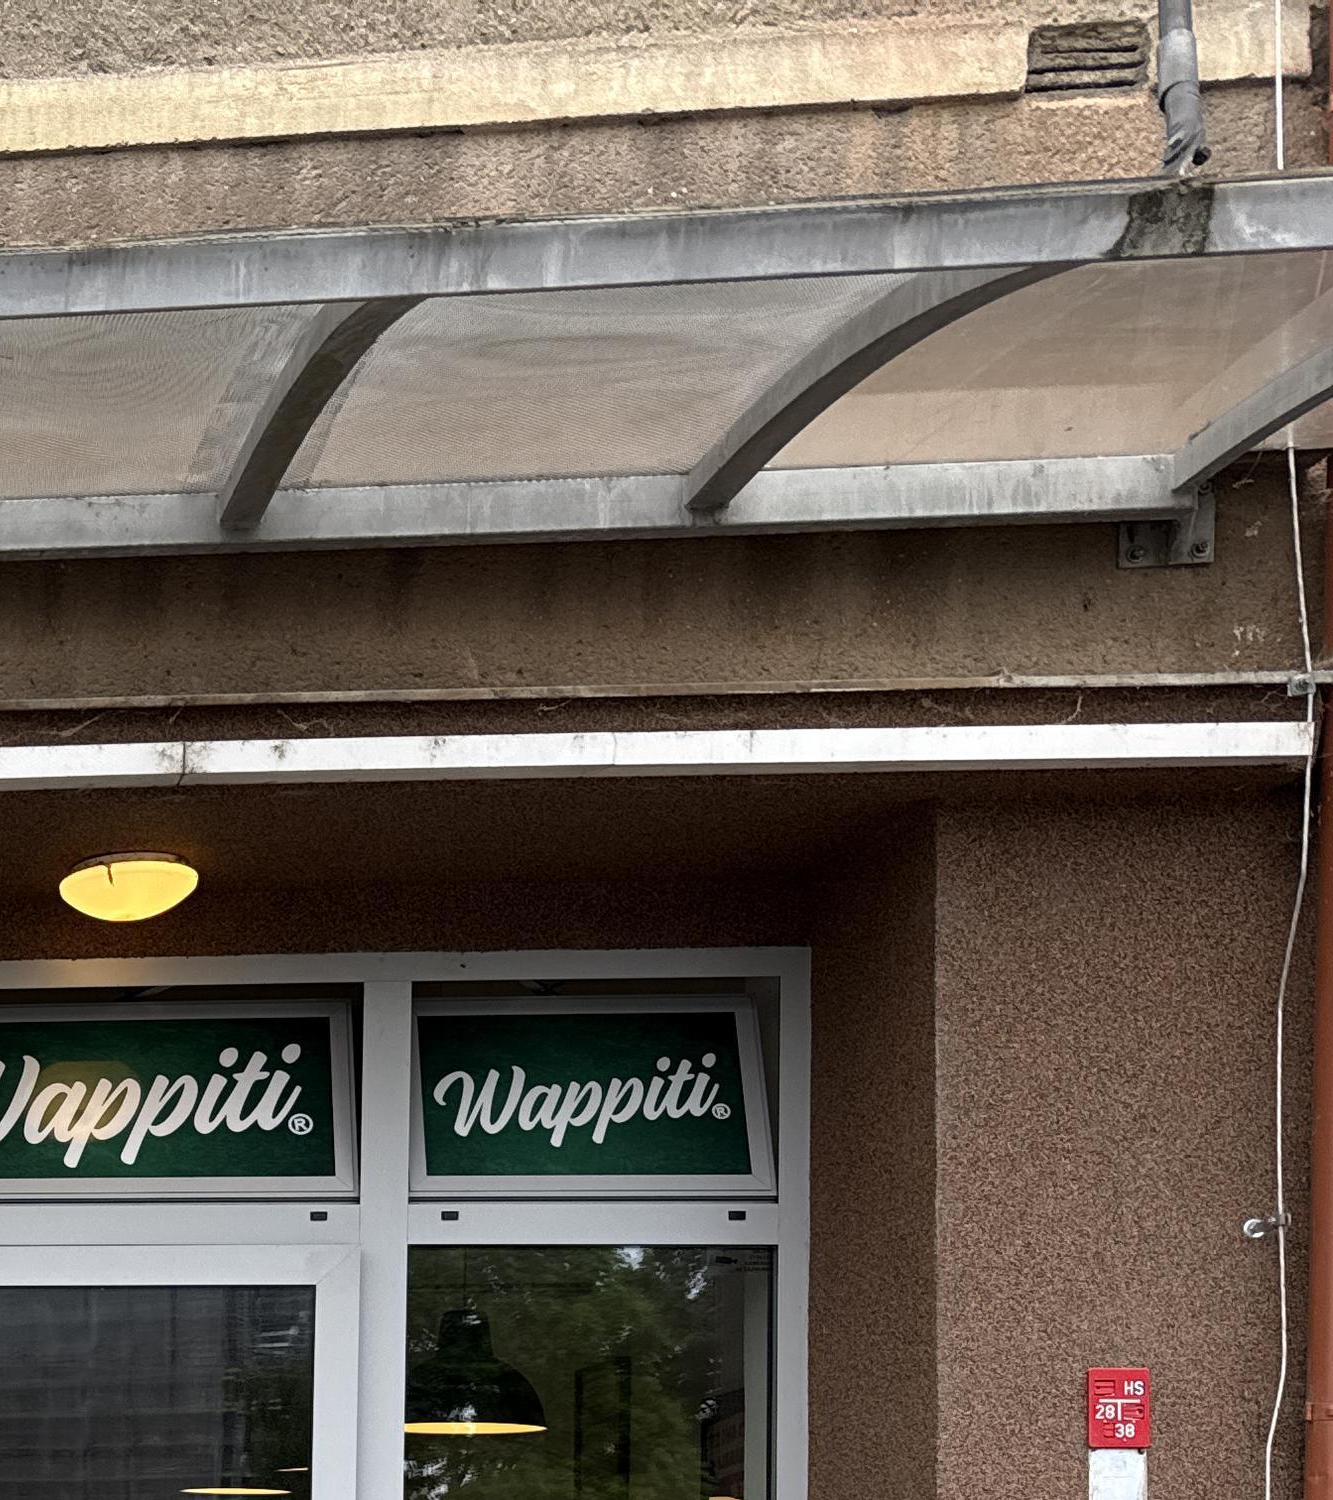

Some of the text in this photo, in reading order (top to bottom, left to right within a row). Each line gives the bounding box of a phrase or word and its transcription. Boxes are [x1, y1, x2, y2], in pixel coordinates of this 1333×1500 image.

[1124, 1381, 1145, 1395] HS
[1095, 1405, 1116, 1419] 28
[1115, 1423, 1135, 1438] 38
